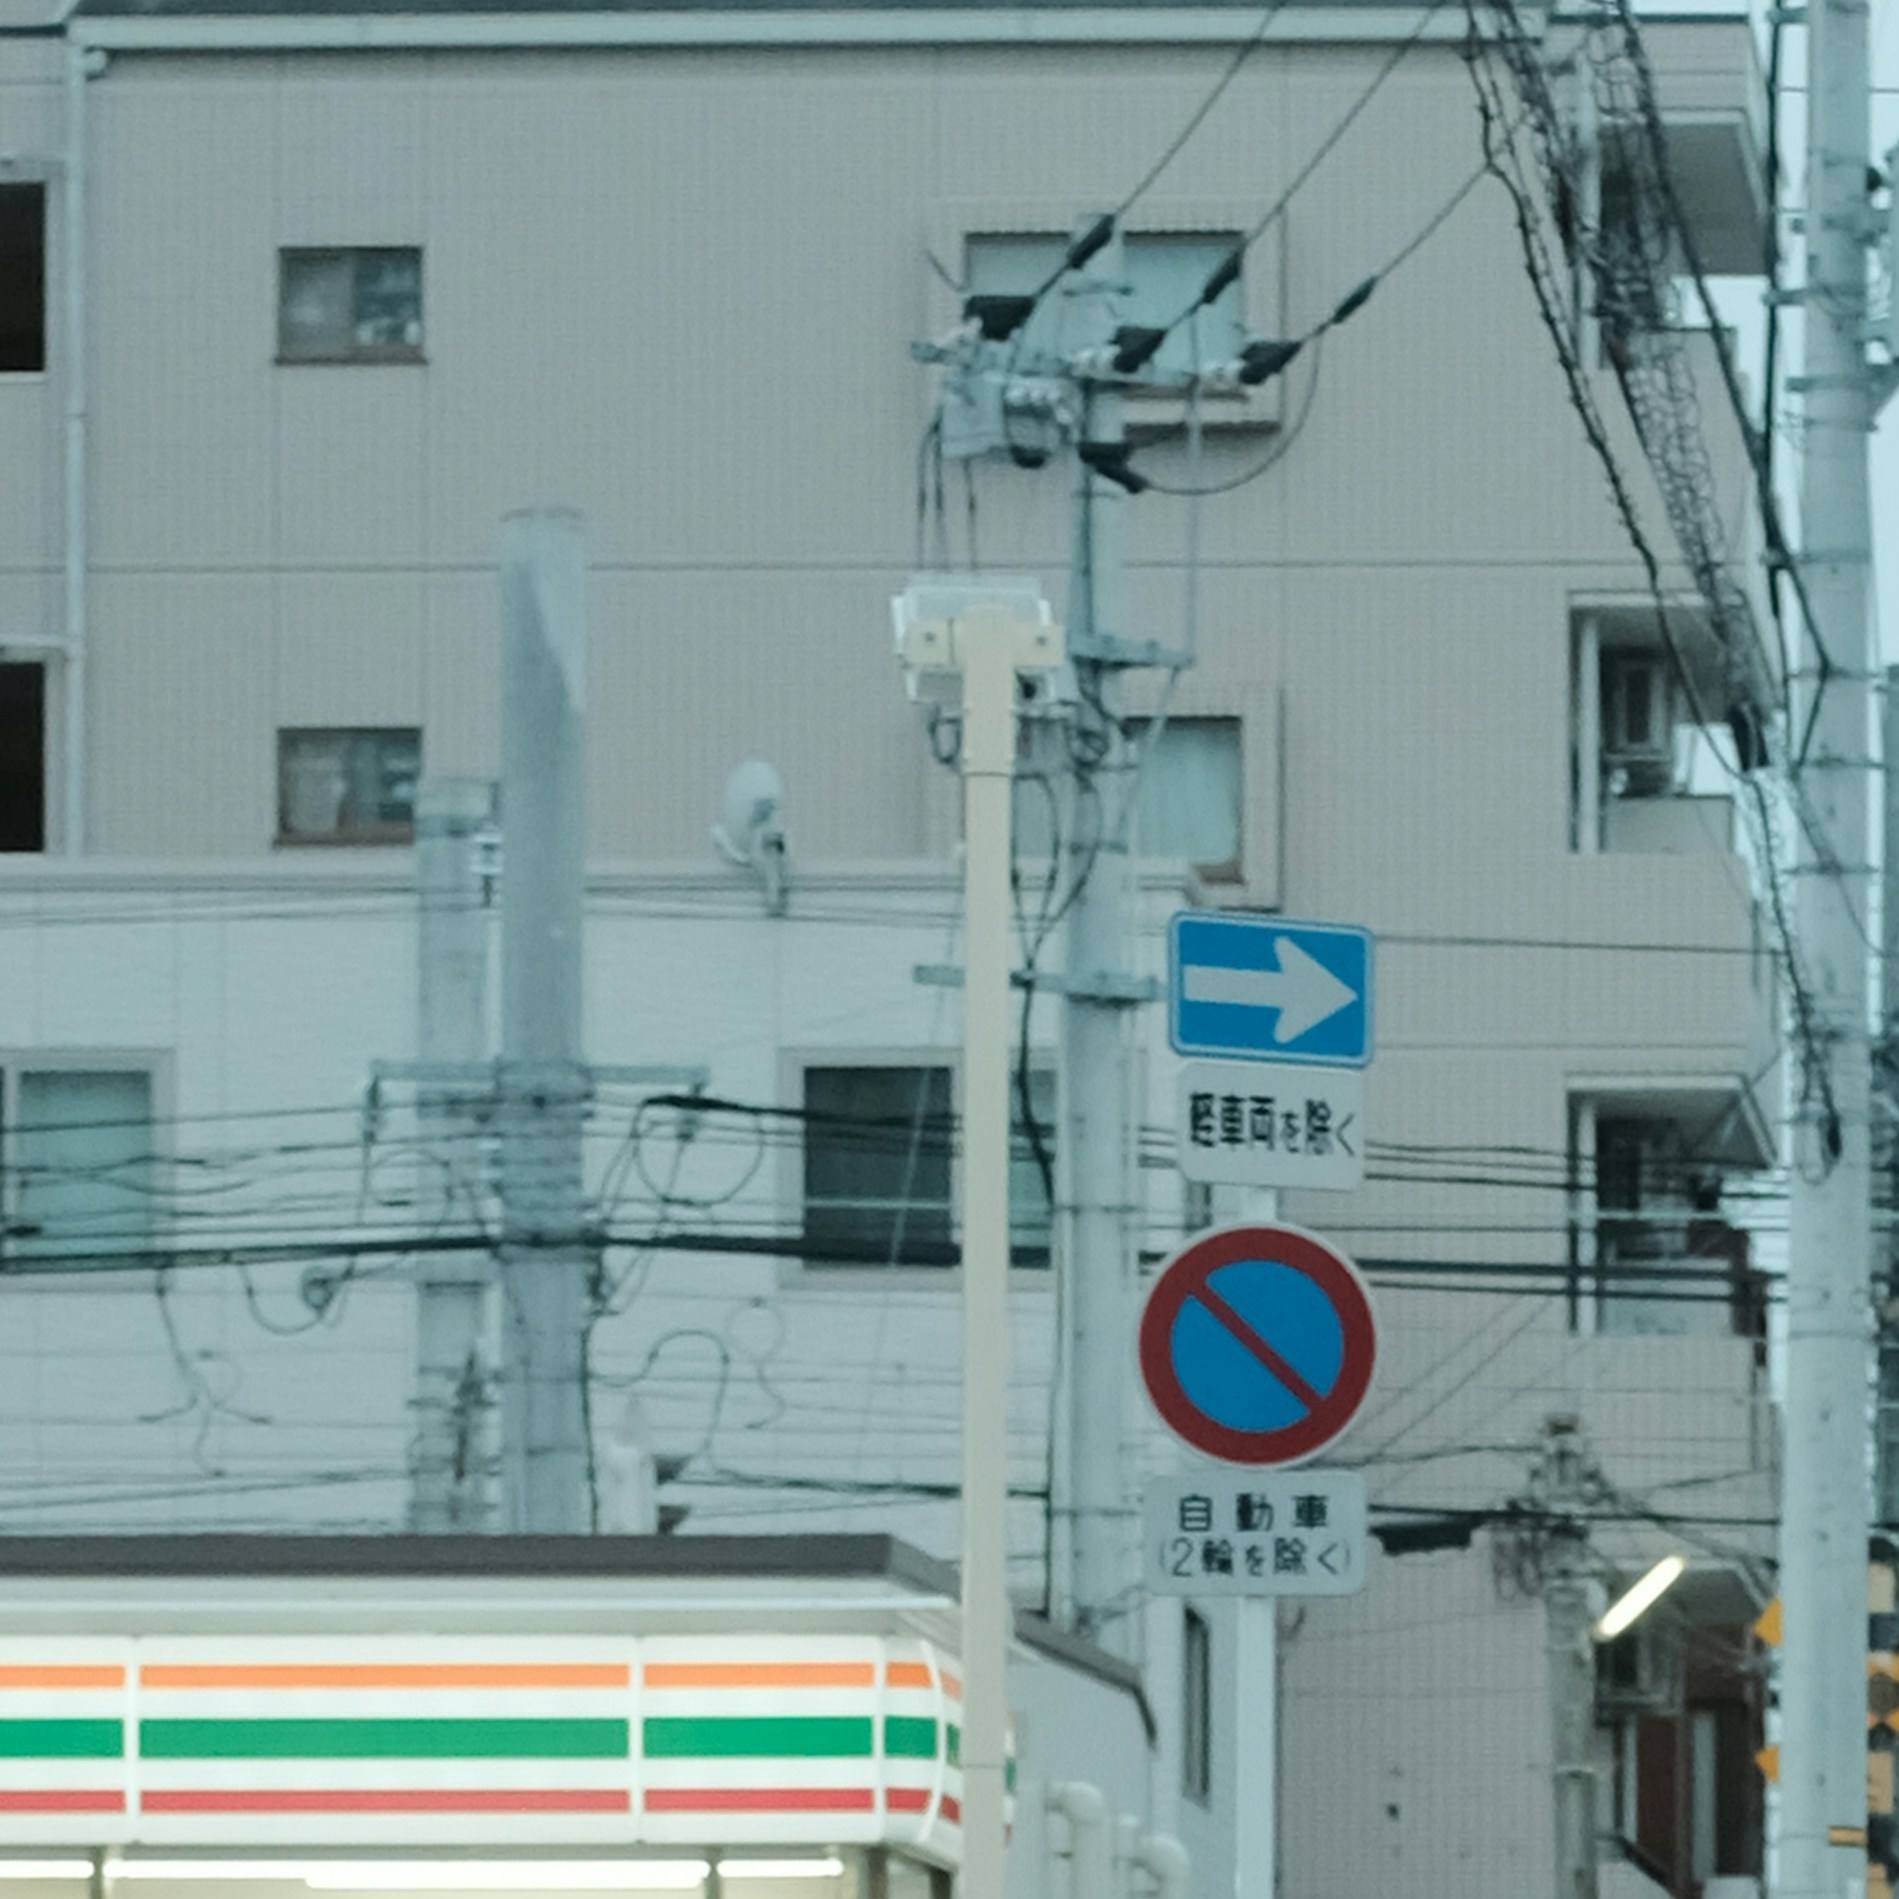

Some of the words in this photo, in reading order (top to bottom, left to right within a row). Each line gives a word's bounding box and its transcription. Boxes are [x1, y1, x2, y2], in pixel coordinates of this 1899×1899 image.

[1189, 1092, 1356, 1157] 軽車両を除く
[1178, 1494, 1330, 1533] 自動車
